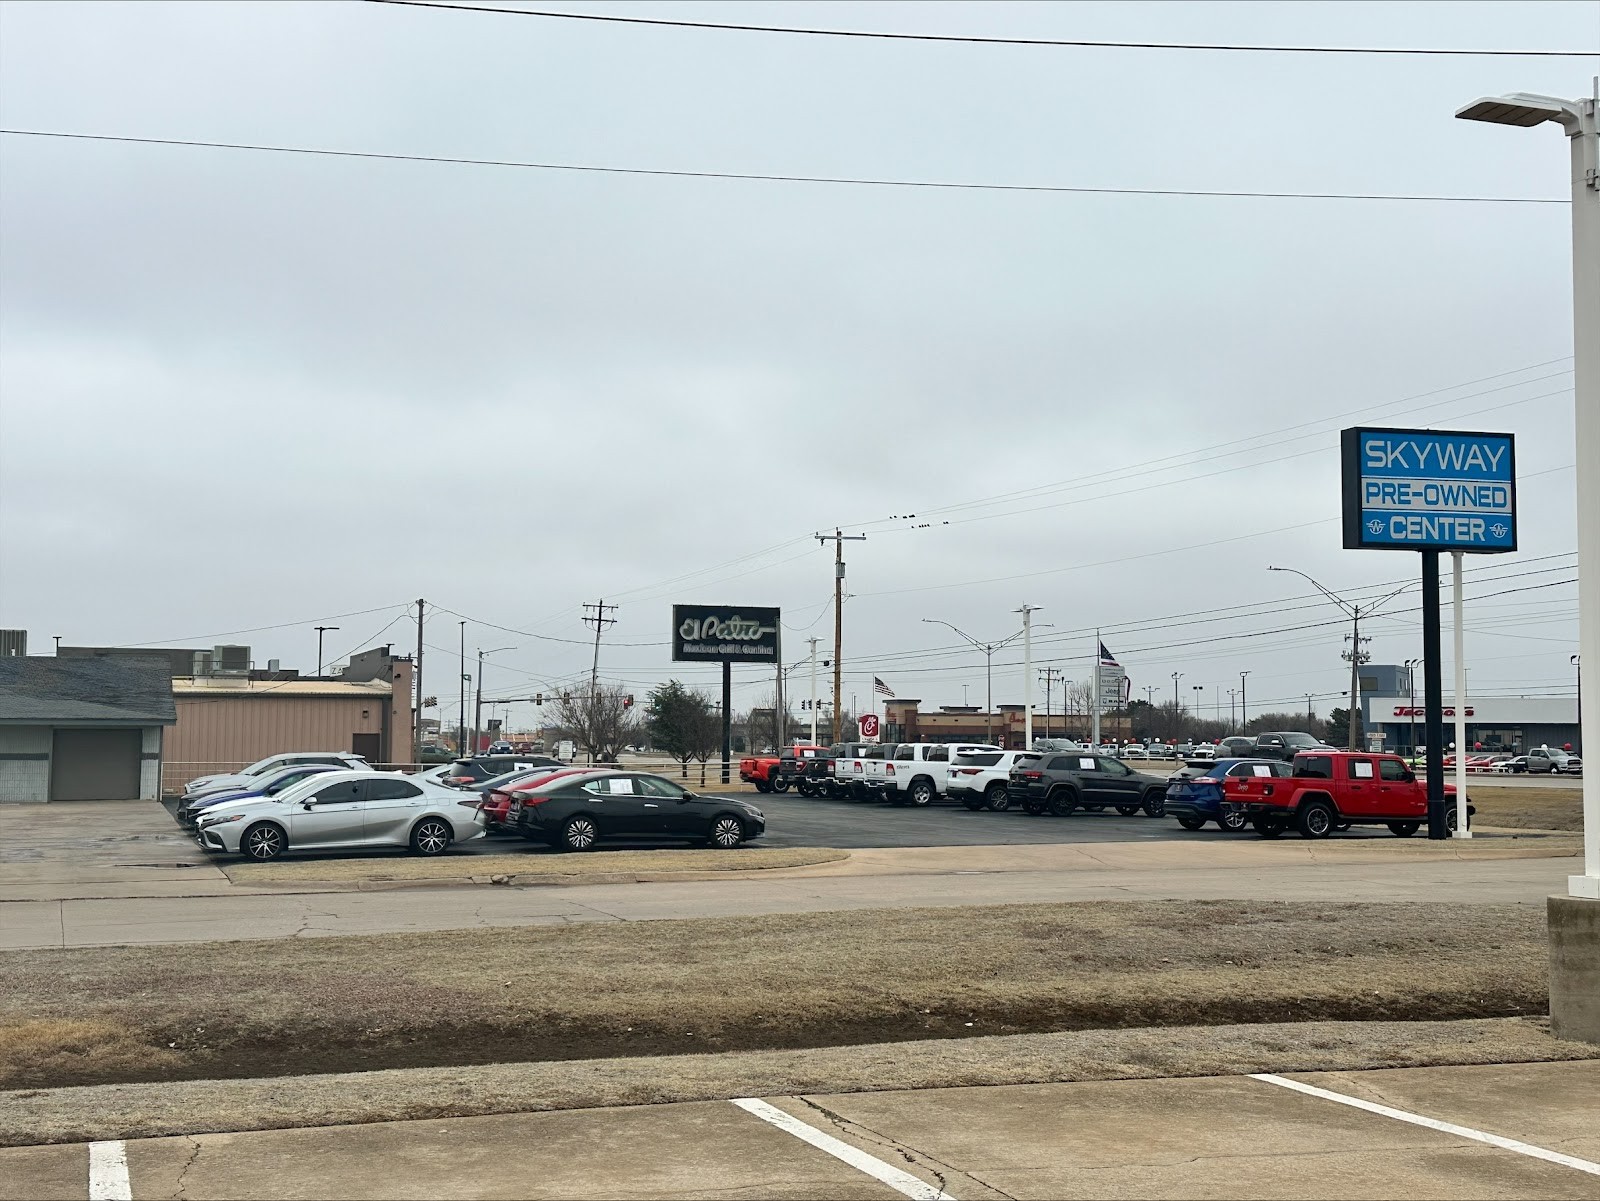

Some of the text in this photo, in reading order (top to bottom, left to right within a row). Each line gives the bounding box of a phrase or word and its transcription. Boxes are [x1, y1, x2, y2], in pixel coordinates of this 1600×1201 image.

[1365, 440, 1506, 472] SKYWAY
[1365, 482, 1507, 508] PRE-OWNED
[1389, 516, 1486, 541] CENTER
[701, 615, 776, 640] Patio
[682, 643, 719, 653] Mexican
